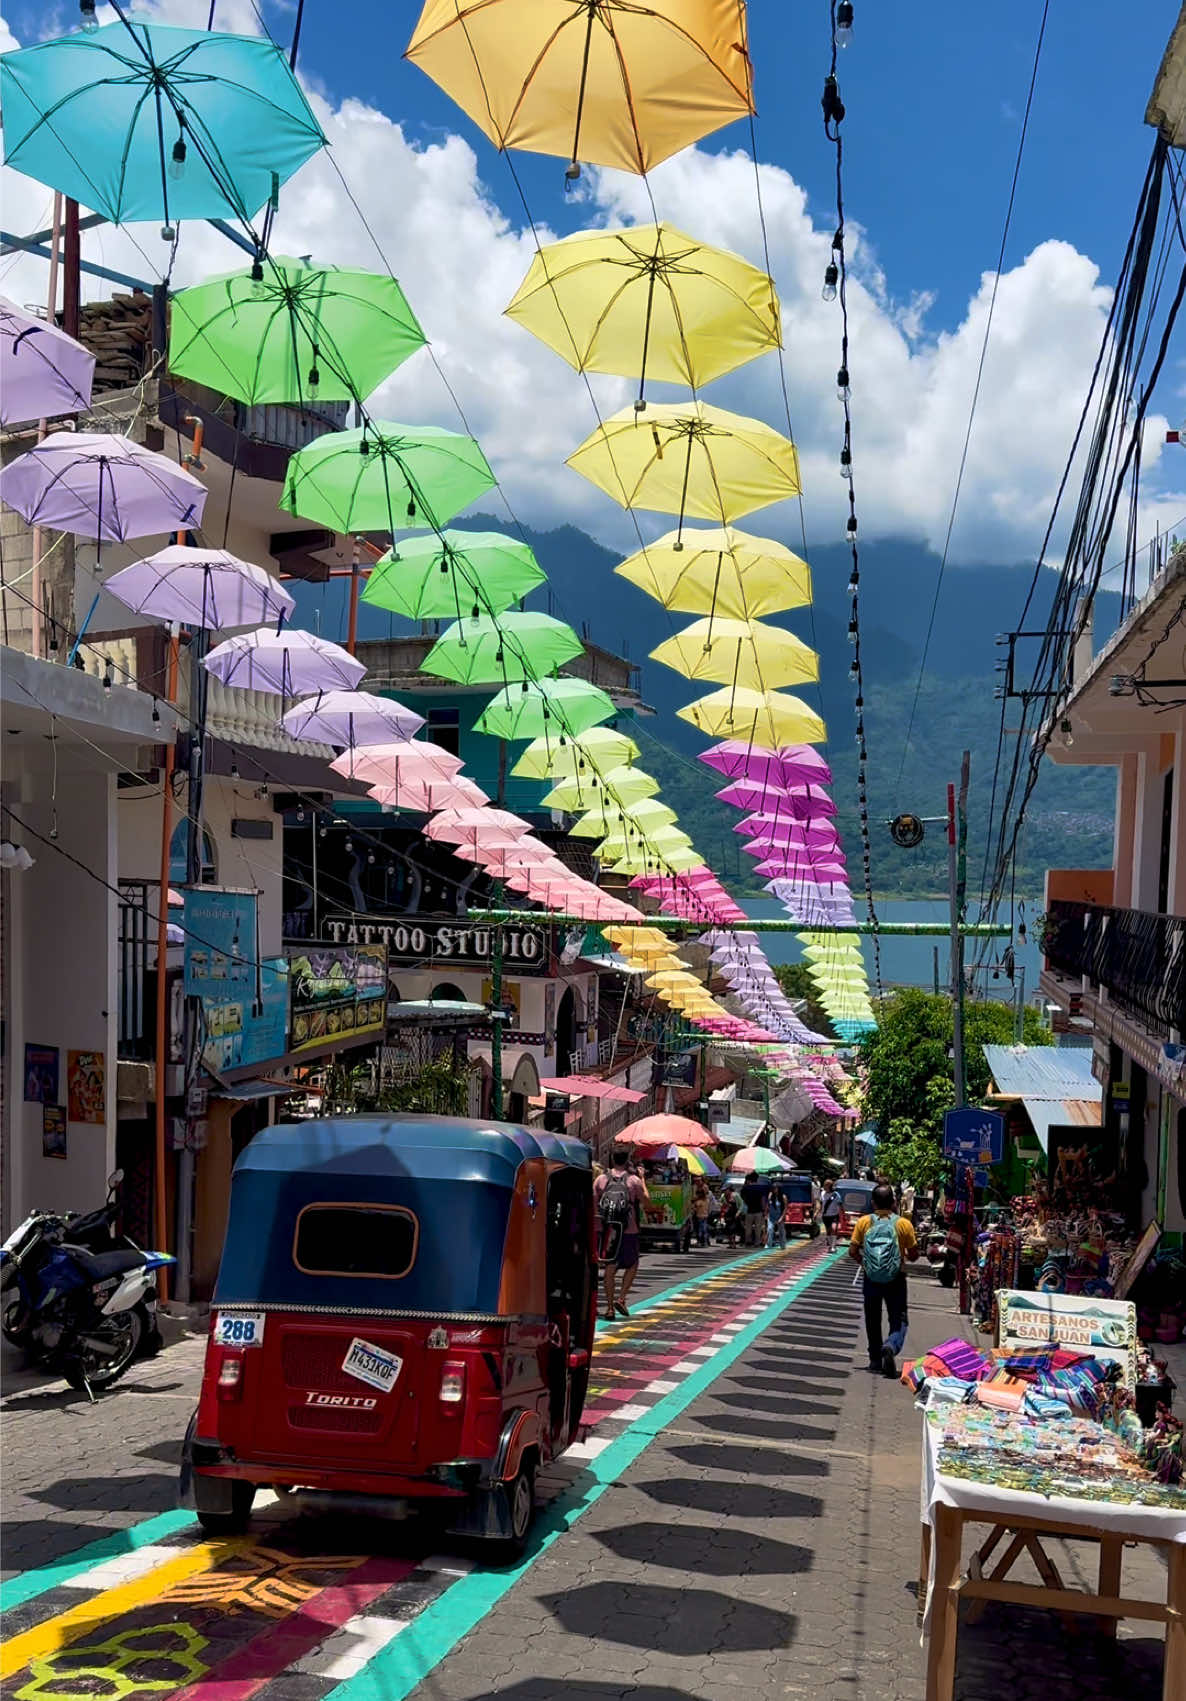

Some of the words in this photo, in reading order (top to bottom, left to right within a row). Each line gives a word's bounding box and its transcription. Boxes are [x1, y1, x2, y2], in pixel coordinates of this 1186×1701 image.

[327, 921, 426, 952] TATTOO
[222, 1319, 256, 1341] 288
[1011, 1310, 1099, 1330] ARTESANOS
[1019, 1325, 1049, 1339] SAN
[1051, 1330, 1090, 1344] JUAN
[305, 1391, 378, 1408] TORITO
